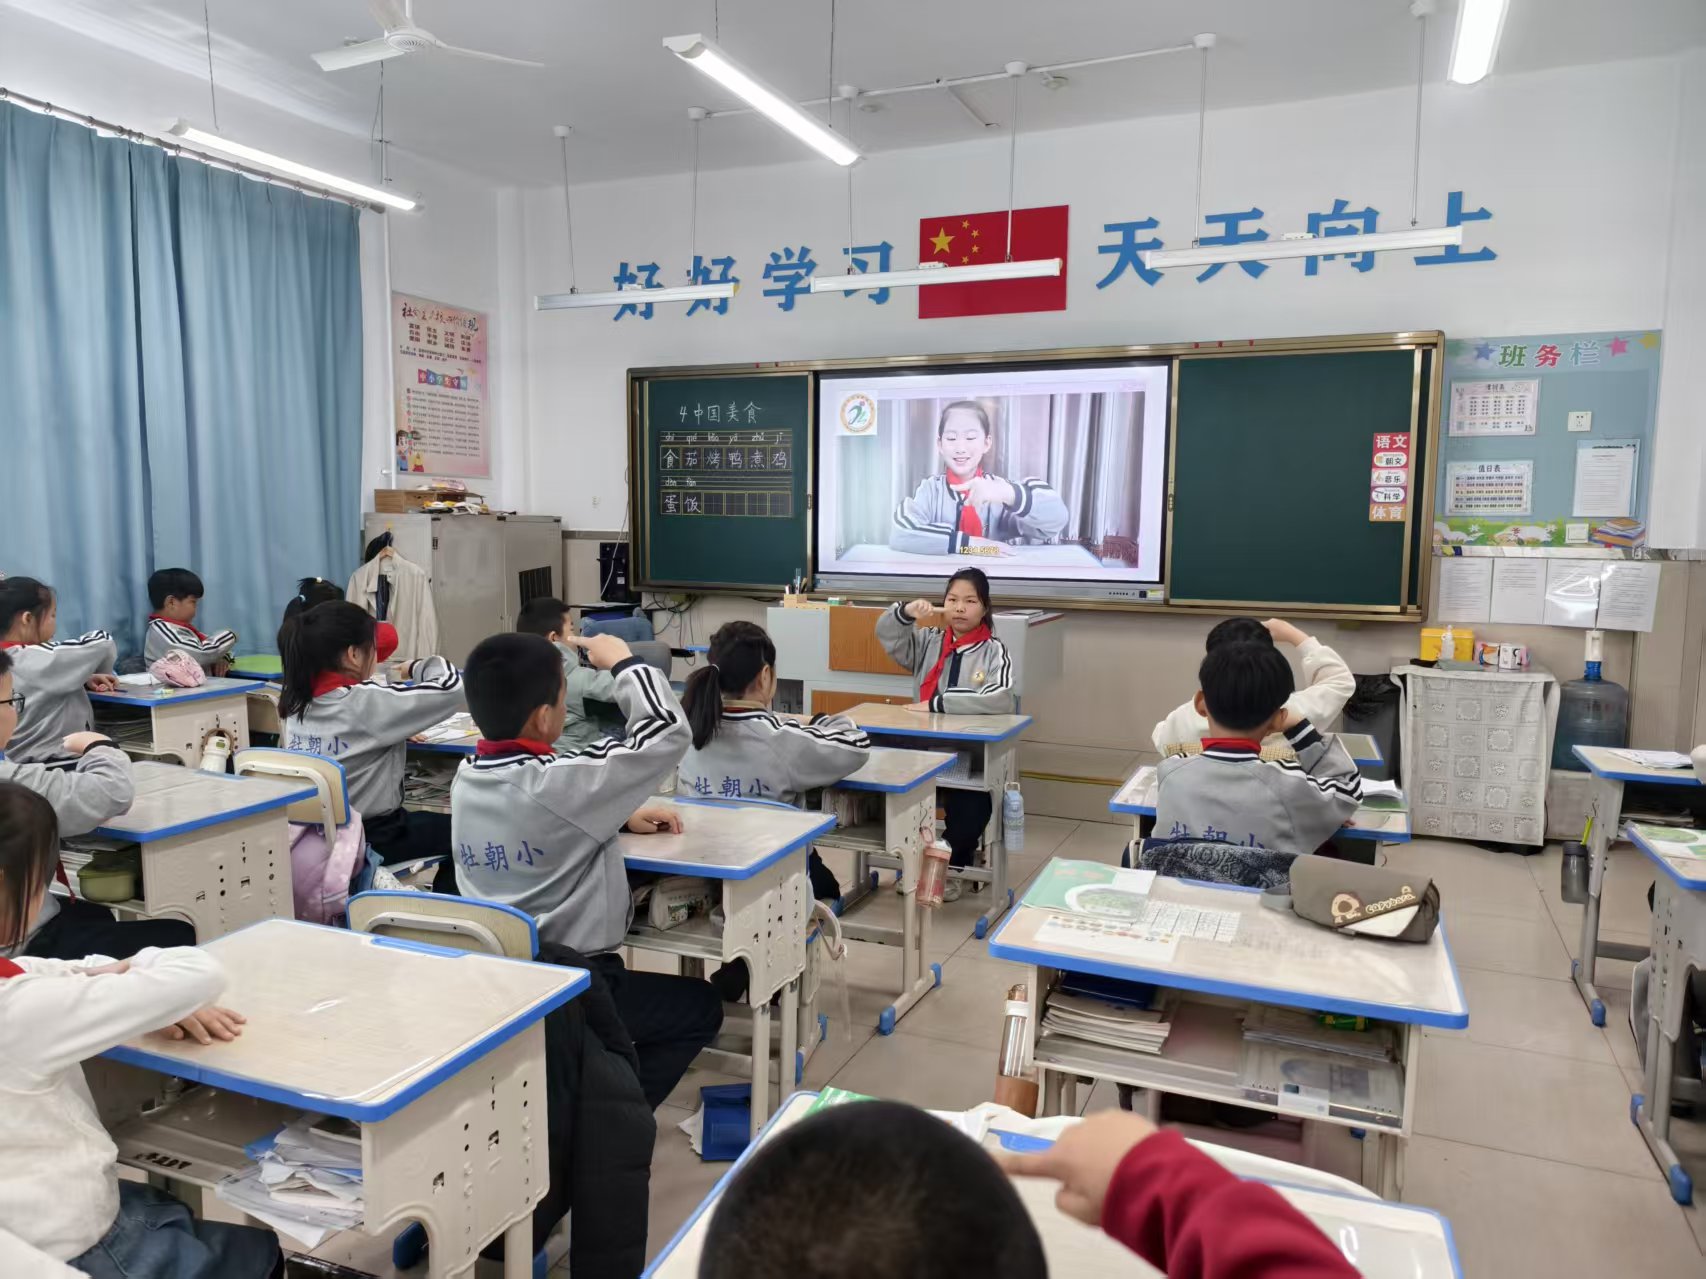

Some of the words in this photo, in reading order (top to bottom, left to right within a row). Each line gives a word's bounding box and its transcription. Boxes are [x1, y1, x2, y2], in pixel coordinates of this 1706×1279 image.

[613, 241, 894, 321] 好好学习
[1095, 191, 1499, 290] 天天向上
[1498, 340, 1600, 369] 班务栏
[679, 406, 688, 423] 4
[694, 401, 763, 425] 中国美食
[1376, 434, 1408, 449] 语文
[1478, 464, 1501, 473] 值日表
[1384, 475, 1401, 483] 音乐
[1383, 493, 1401, 501] 科学
[1372, 505, 1404, 520] 体育
[695, 775, 770, 797] 牡朝小
[460, 840, 544, 872] 牡朝小
